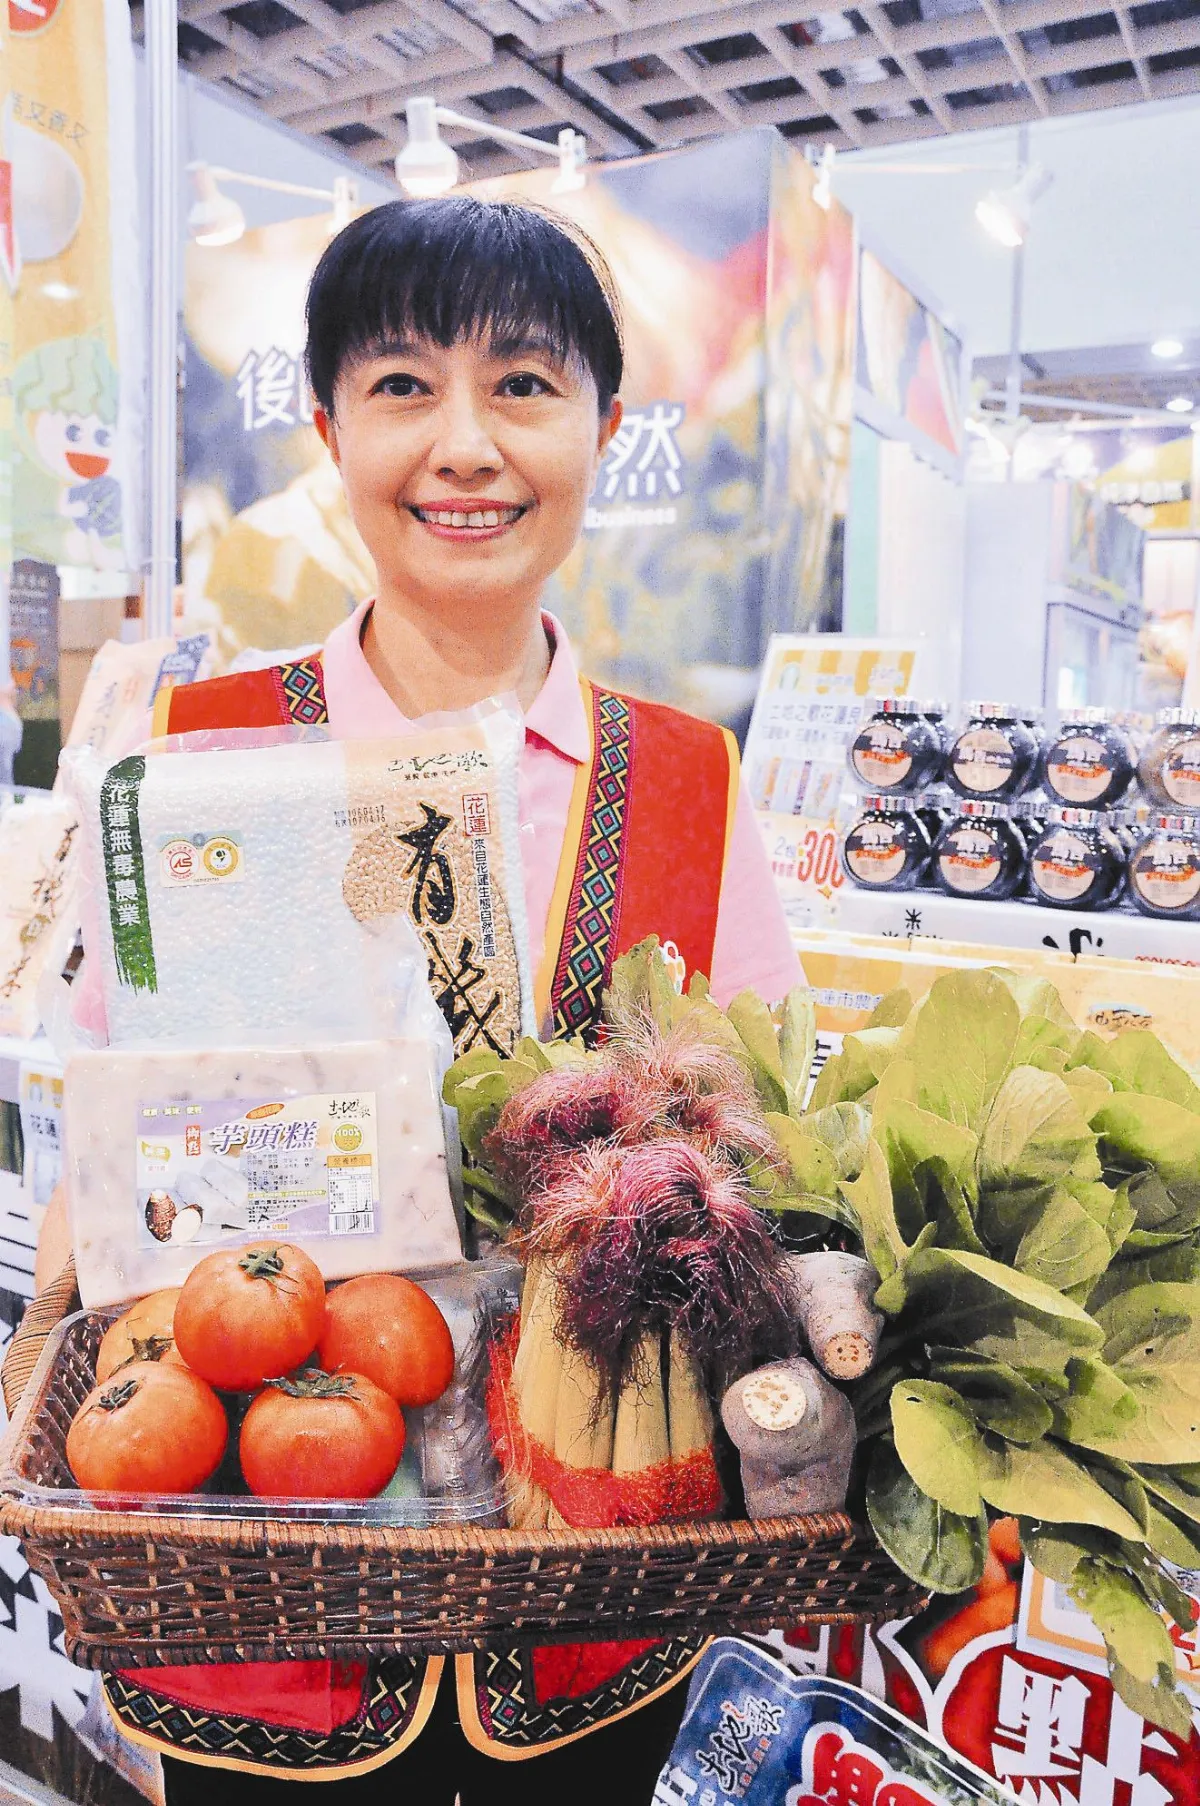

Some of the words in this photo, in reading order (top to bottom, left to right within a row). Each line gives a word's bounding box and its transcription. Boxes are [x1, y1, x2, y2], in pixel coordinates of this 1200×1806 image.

[603, 405, 682, 497] 然
[466, 797, 488, 833] 花蓮
[107, 782, 141, 927] 花蓮無毒農業
[209, 1121, 318, 1154] 芋頭糕
